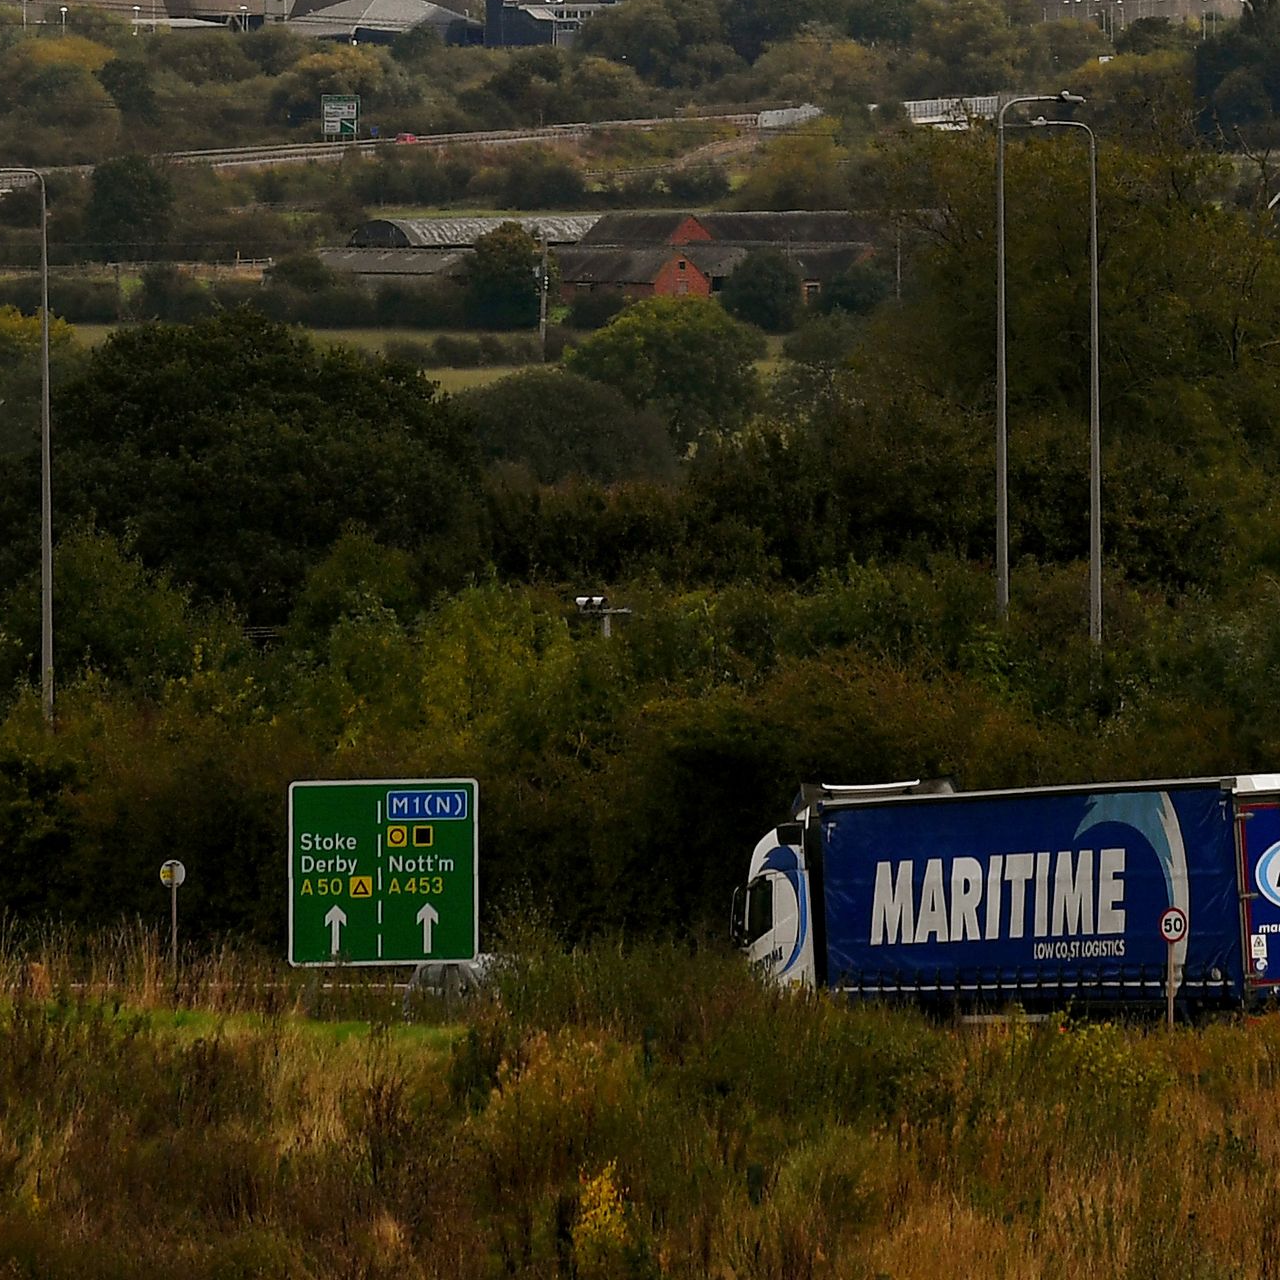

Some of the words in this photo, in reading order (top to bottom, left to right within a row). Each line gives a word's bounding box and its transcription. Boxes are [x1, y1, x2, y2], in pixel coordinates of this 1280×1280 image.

[392, 793, 463, 816] M1(N)
[300, 832, 357, 851] Stoke
[301, 855, 358, 875] Derby
[389, 854, 454, 873] Nott'm
[870, 848, 1125, 946] MARITIME
[1164, 918, 1182, 933] 50
[1033, 942, 1054, 960] LOW
[1081, 939, 1125, 957] LOGISTICS
